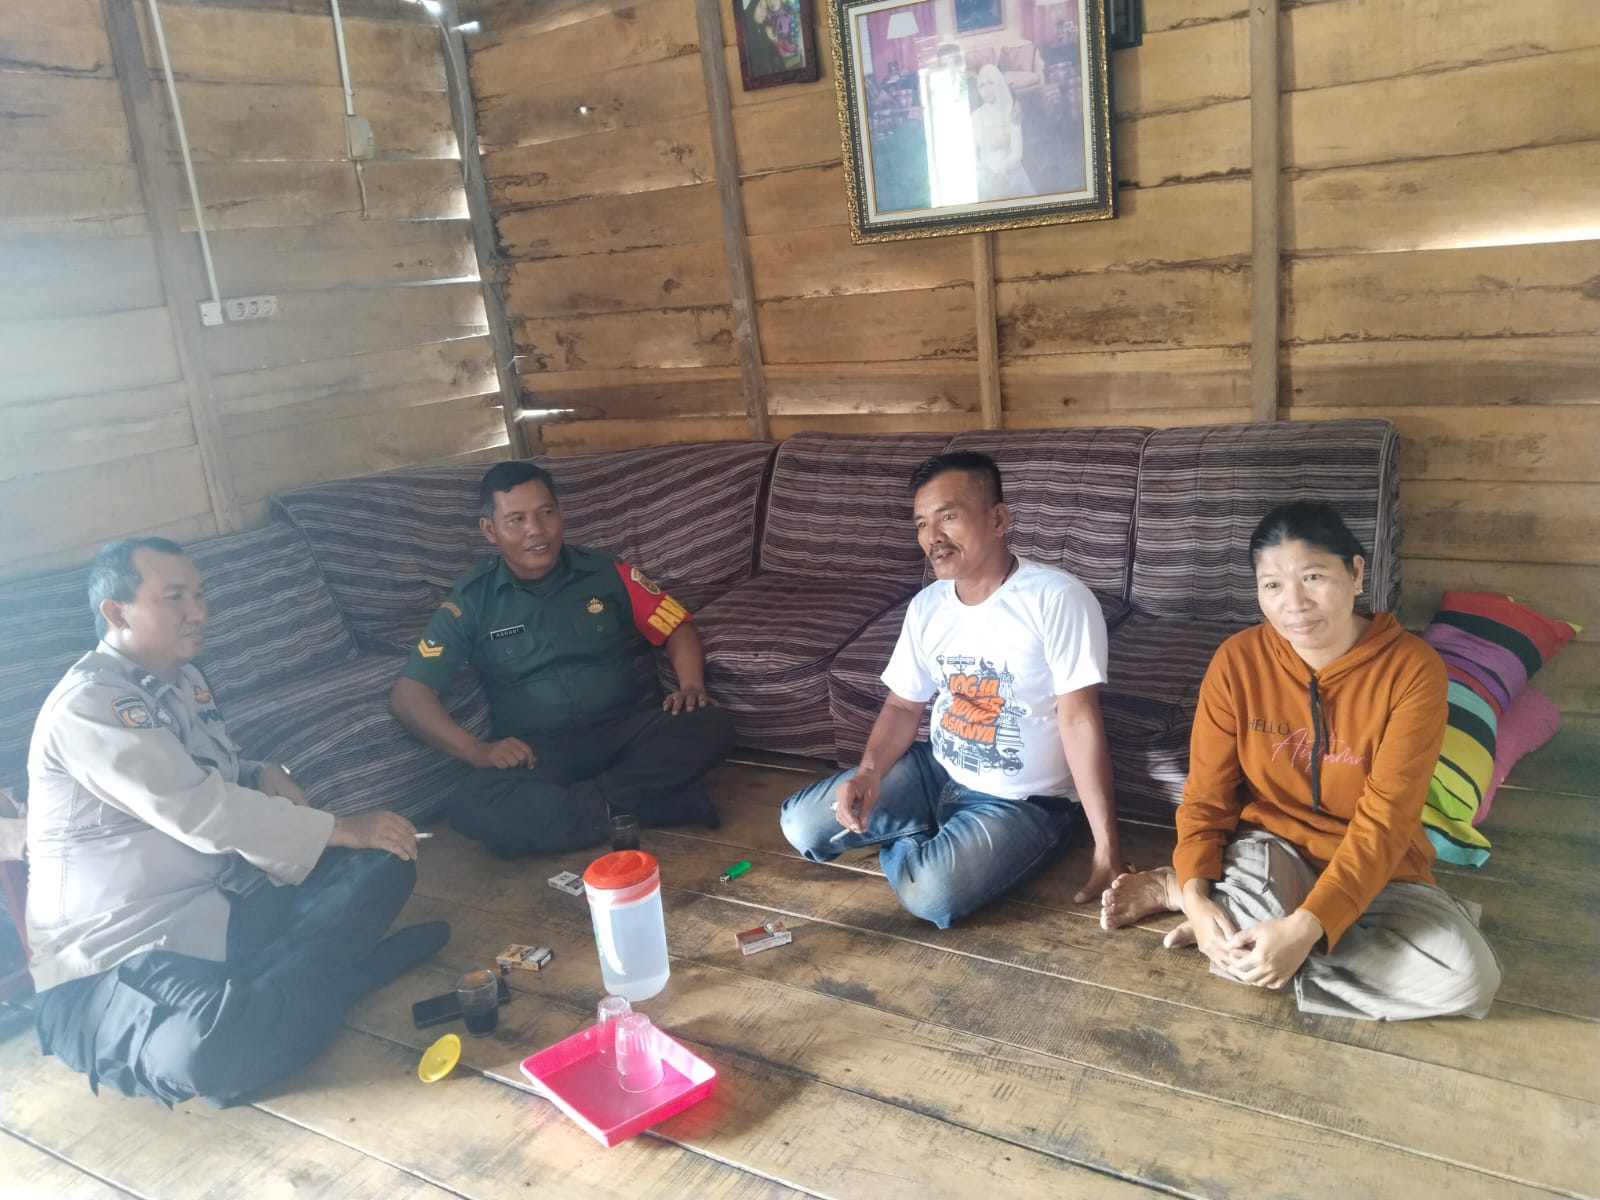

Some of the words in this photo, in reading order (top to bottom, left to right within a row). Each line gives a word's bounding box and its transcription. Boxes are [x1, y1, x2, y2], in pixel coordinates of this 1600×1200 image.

[949, 674, 999, 698] JOGJA
[941, 713, 996, 743] ASIKNYA
[1250, 718, 1290, 736] HELLO
